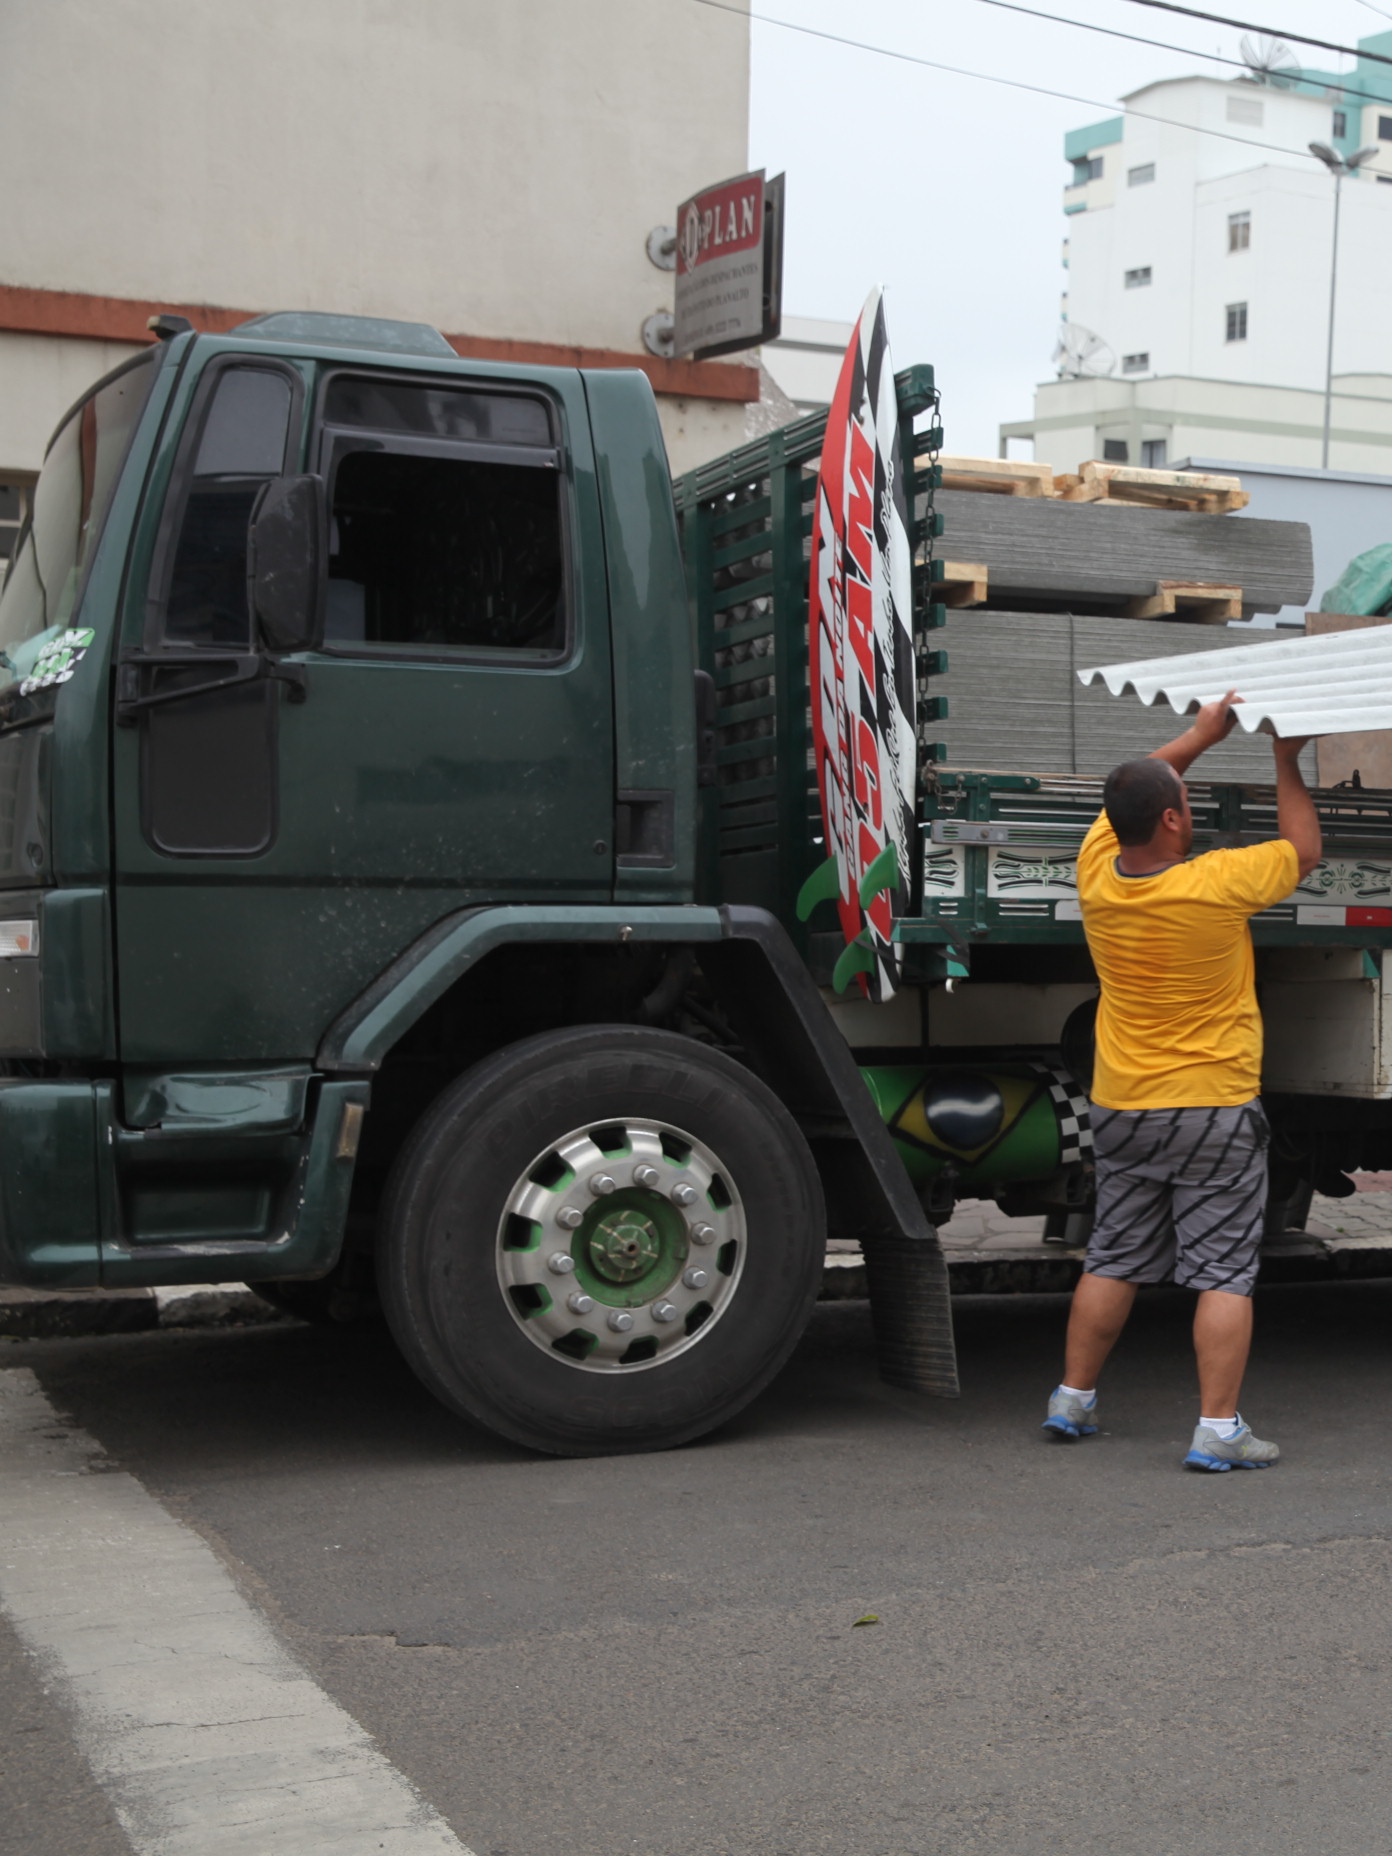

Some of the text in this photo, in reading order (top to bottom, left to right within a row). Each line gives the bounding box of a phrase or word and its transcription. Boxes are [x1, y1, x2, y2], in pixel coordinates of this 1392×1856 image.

[834, 530, 844, 671] NOITE
[847, 418, 874, 698] AM
[819, 484, 850, 905] GDN
[840, 749, 856, 880] GANG
